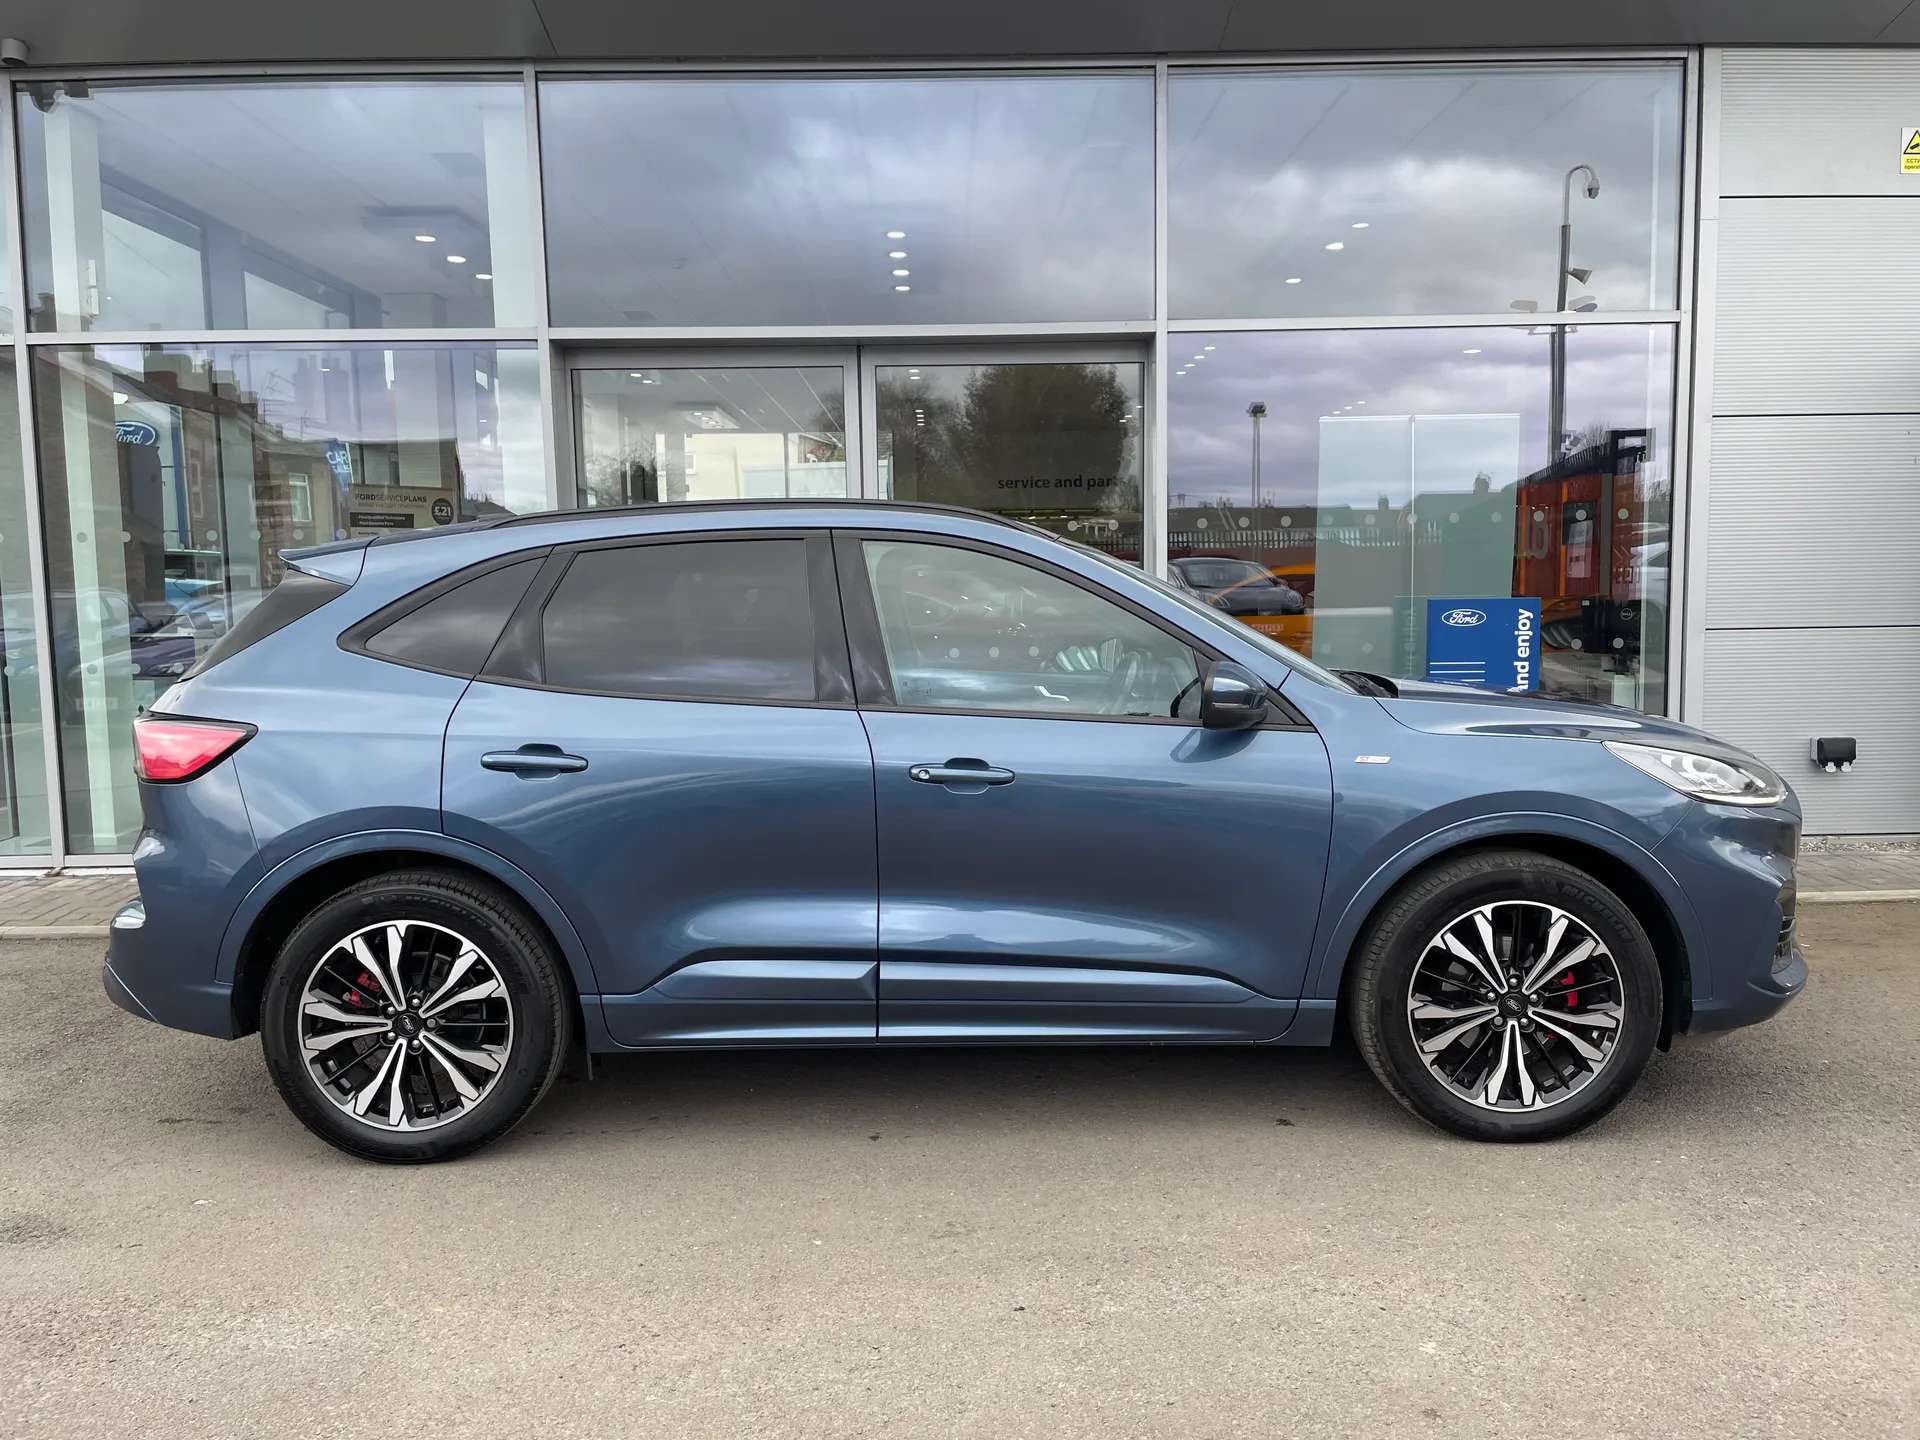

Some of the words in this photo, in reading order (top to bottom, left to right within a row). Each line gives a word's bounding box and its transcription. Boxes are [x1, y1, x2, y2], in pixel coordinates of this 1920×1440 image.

[116, 426, 144, 444] Ford
[998, 476, 1050, 489] service
[1054, 475, 1083, 488] and
[434, 506, 452, 516] £21
[1449, 611, 1480, 624] Ford
[1514, 608, 1534, 658] enjoy
[1562, 885, 1633, 940] MICHELIN
